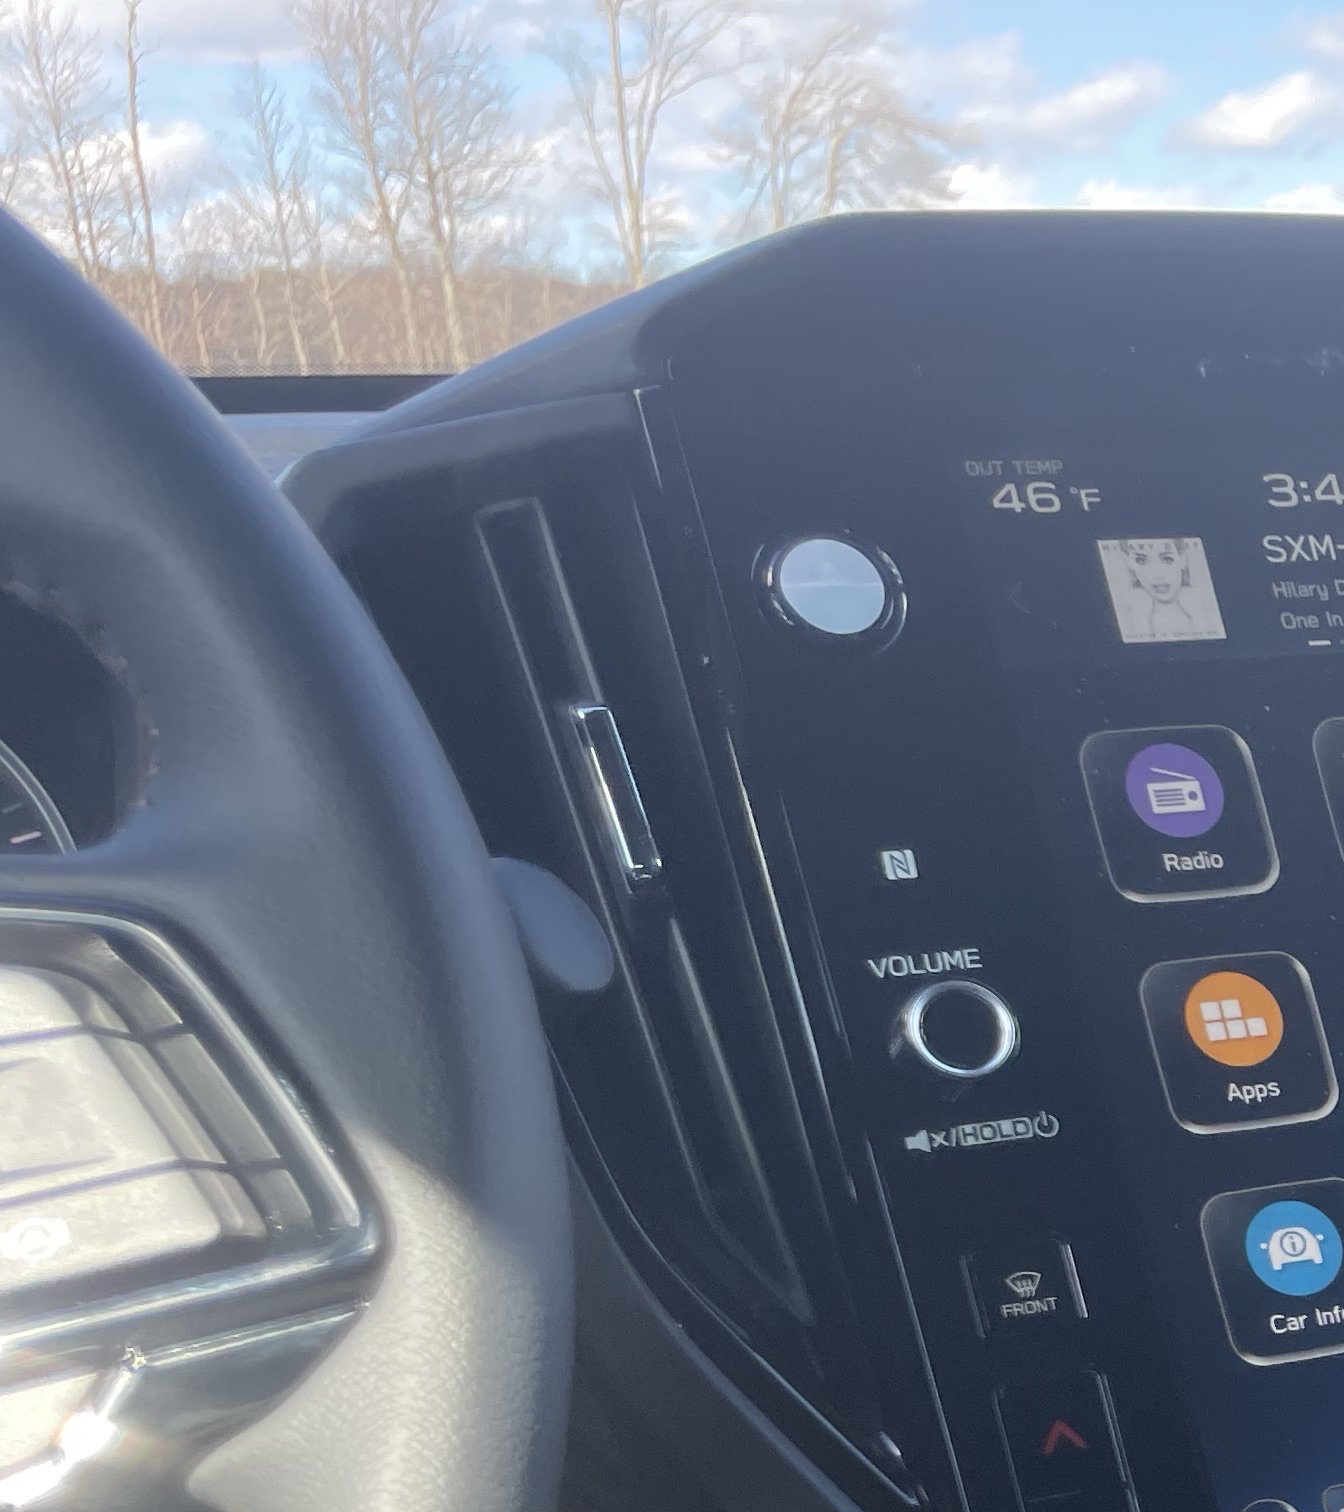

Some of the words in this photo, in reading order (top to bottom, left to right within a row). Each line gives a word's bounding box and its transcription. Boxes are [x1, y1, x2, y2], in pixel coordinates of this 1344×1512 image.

[965, 460, 1003, 477] OUT
[1013, 459, 1064, 475] TEMP
[992, 481, 1061, 513] 46
[1272, 580, 1329, 602] Hilary
[1280, 612, 1320, 629] One
[1326, 610, 1344, 627] In
[1162, 851, 1224, 873] Radio
[867, 948, 983, 978] VOLUME
[1227, 1081, 1281, 1104] Apps
[1001, 1296, 1058, 1318] FRONT
[1269, 1310, 1307, 1335] Car
